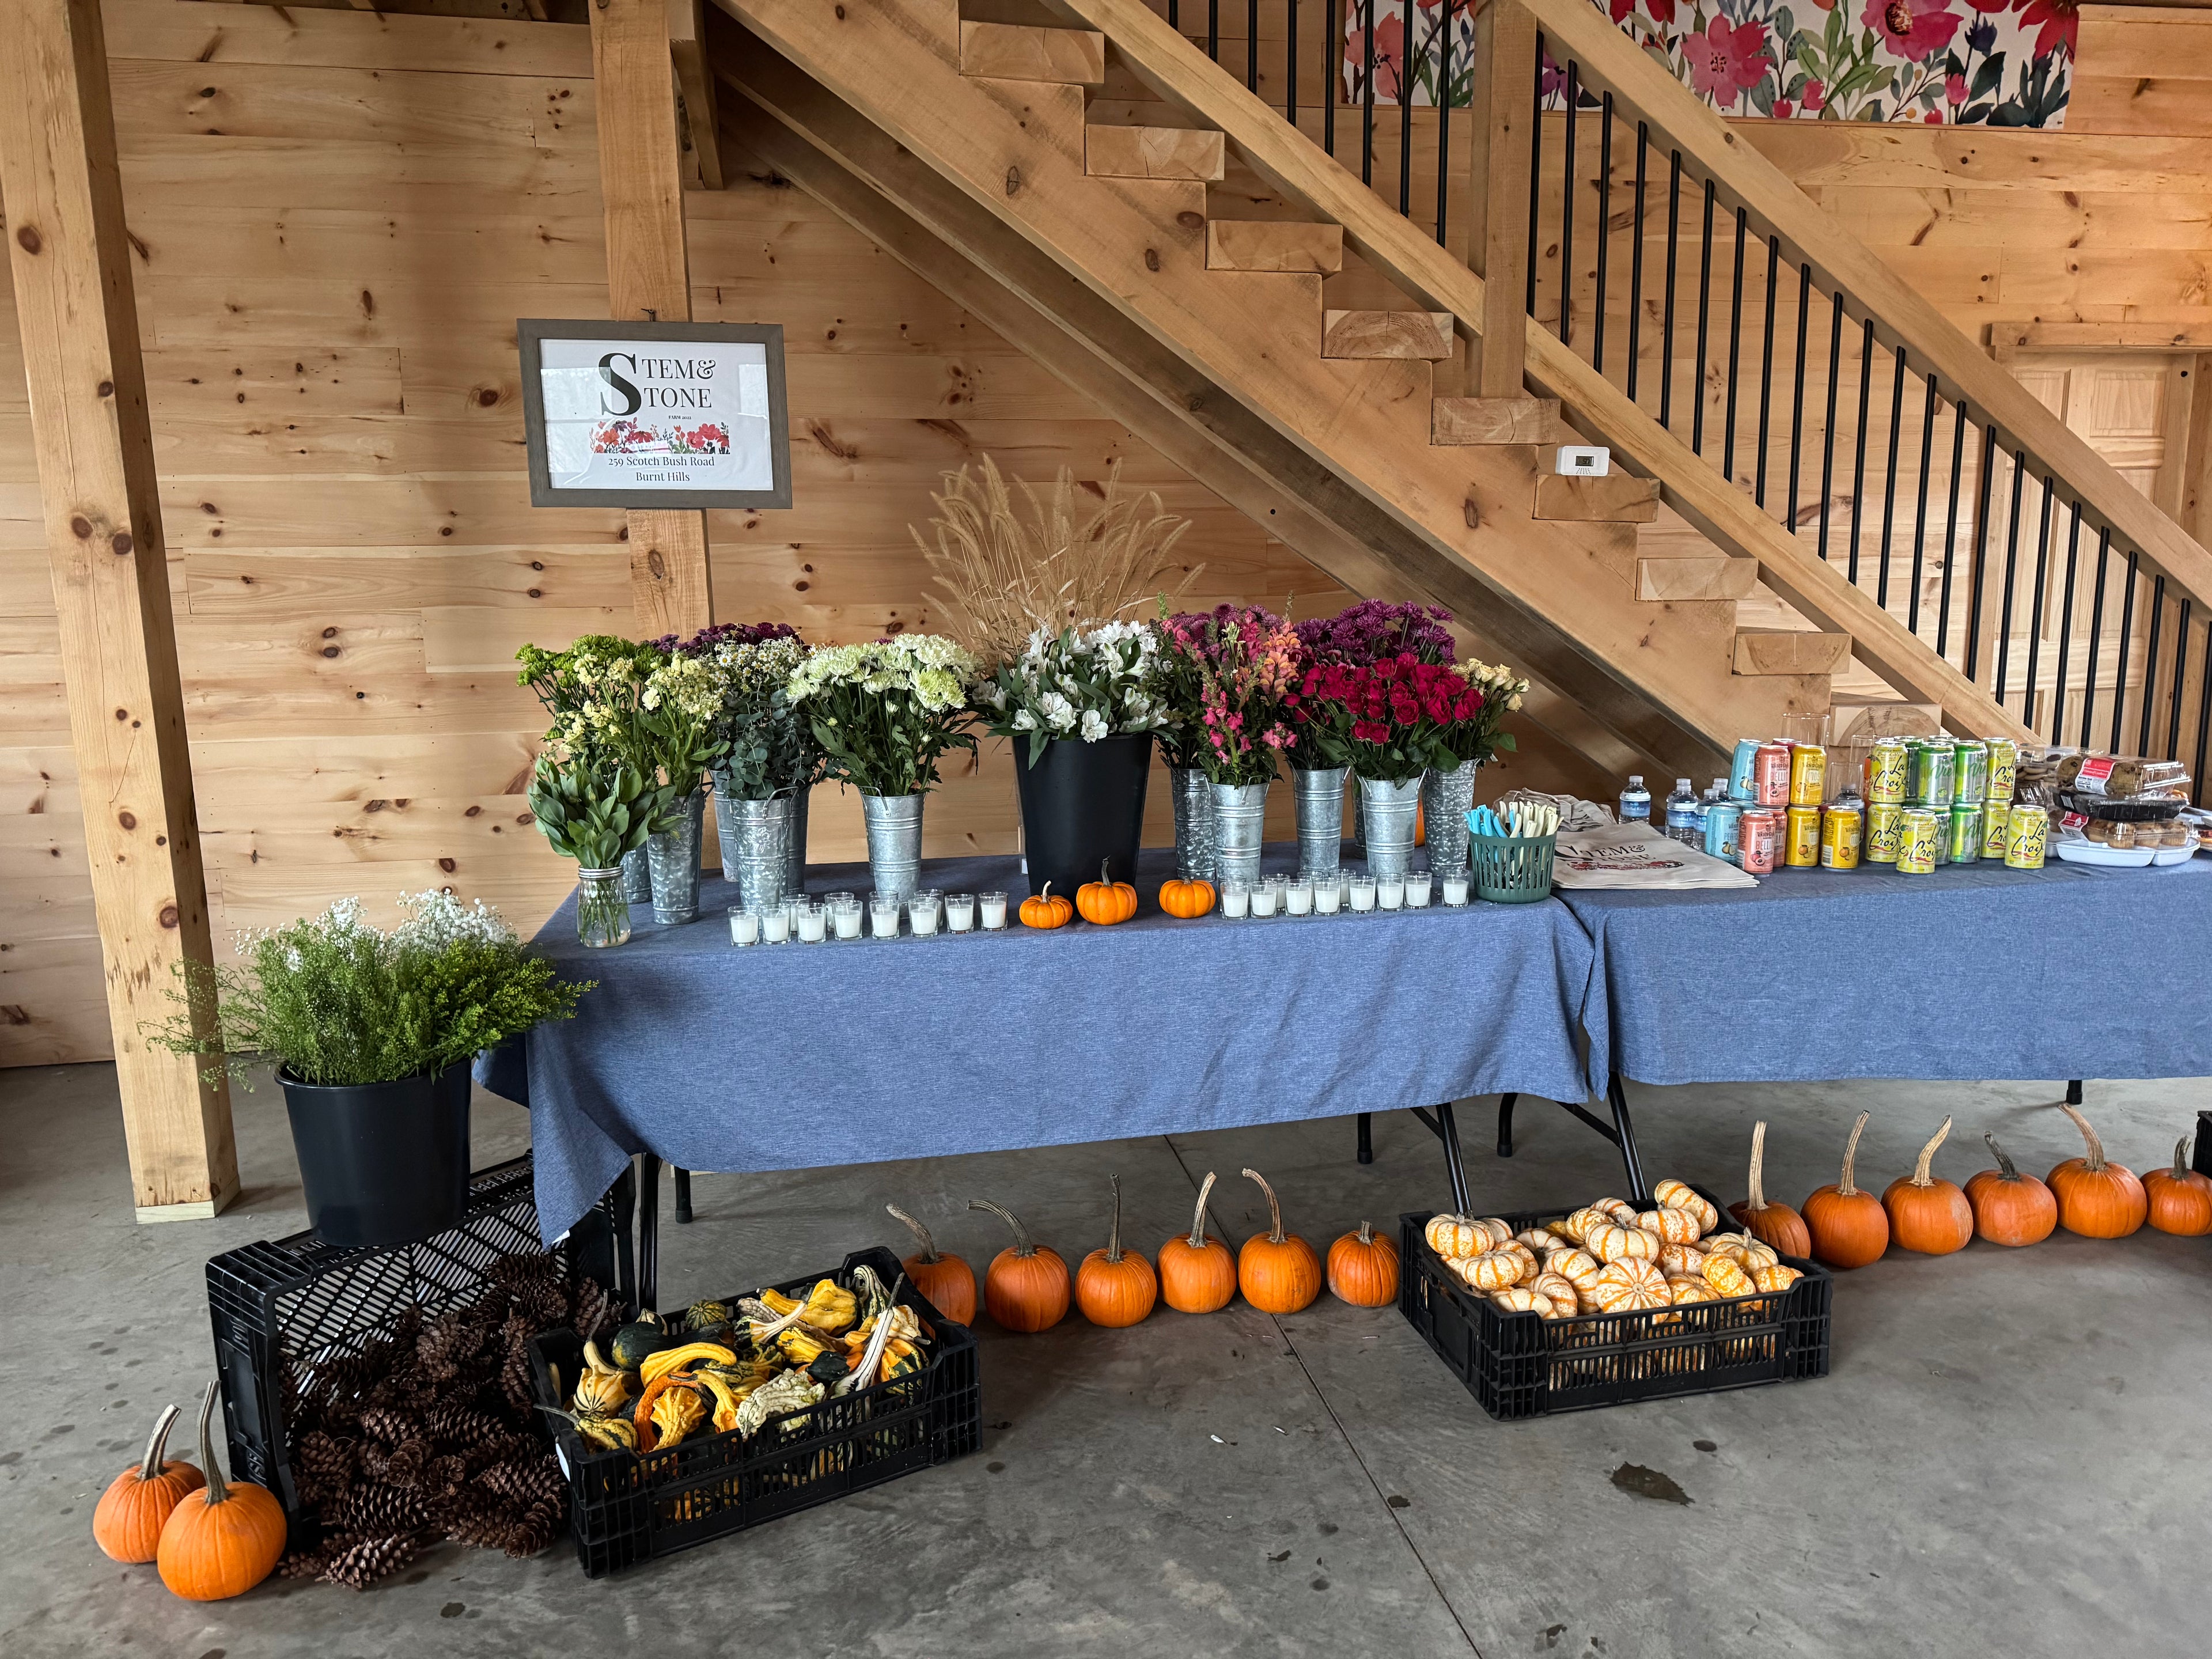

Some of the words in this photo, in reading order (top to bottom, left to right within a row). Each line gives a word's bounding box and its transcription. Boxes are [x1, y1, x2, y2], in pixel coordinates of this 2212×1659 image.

[608, 457, 624, 467] 259
[627, 456, 660, 465] Scotch
[662, 456, 687, 466] Bush
[691, 457, 715, 466] Road
[637, 472, 665, 481] Burnt
[668, 471, 690, 482] Hills
[1889, 755, 1905, 776] La
[1873, 770, 1908, 791] Croix
[2029, 820, 2045, 841] La
[2011, 835, 2045, 856] Croix
